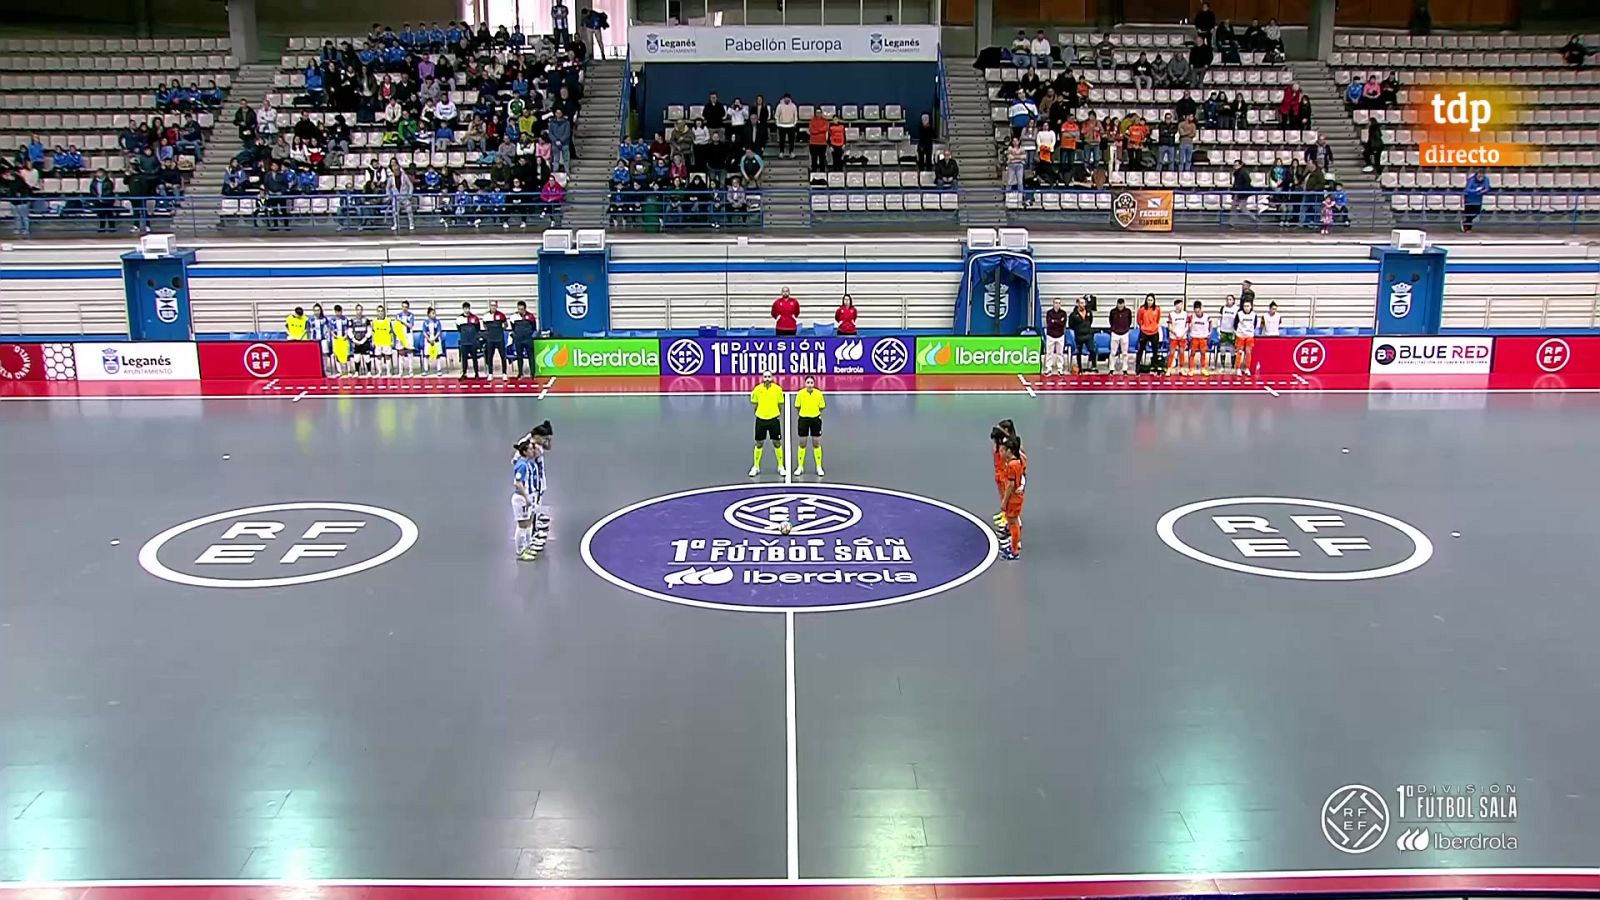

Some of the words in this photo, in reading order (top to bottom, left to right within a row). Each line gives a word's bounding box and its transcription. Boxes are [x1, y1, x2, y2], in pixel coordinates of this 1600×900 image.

[660, 38, 696, 48] Leganés
[725, 37, 786, 51] Pabellón
[791, 38, 842, 53] Europa
[884, 38, 920, 48] Leganés
[731, 339, 825, 350] DIVISIÓN
[1400, 345, 1447, 359] BLUE
[1452, 345, 1489, 359] RED
[121, 355, 171, 368] Leganés
[573, 348, 659, 367] Iberdrola
[731, 350, 786, 374] FÚTBOL
[790, 352, 827, 373] SALA
[955, 347, 1040, 364] Iberdrola
[710, 544, 825, 562] FÚTBOL
[834, 545, 912, 561] SALA
[743, 569, 918, 584] Iberdrola
